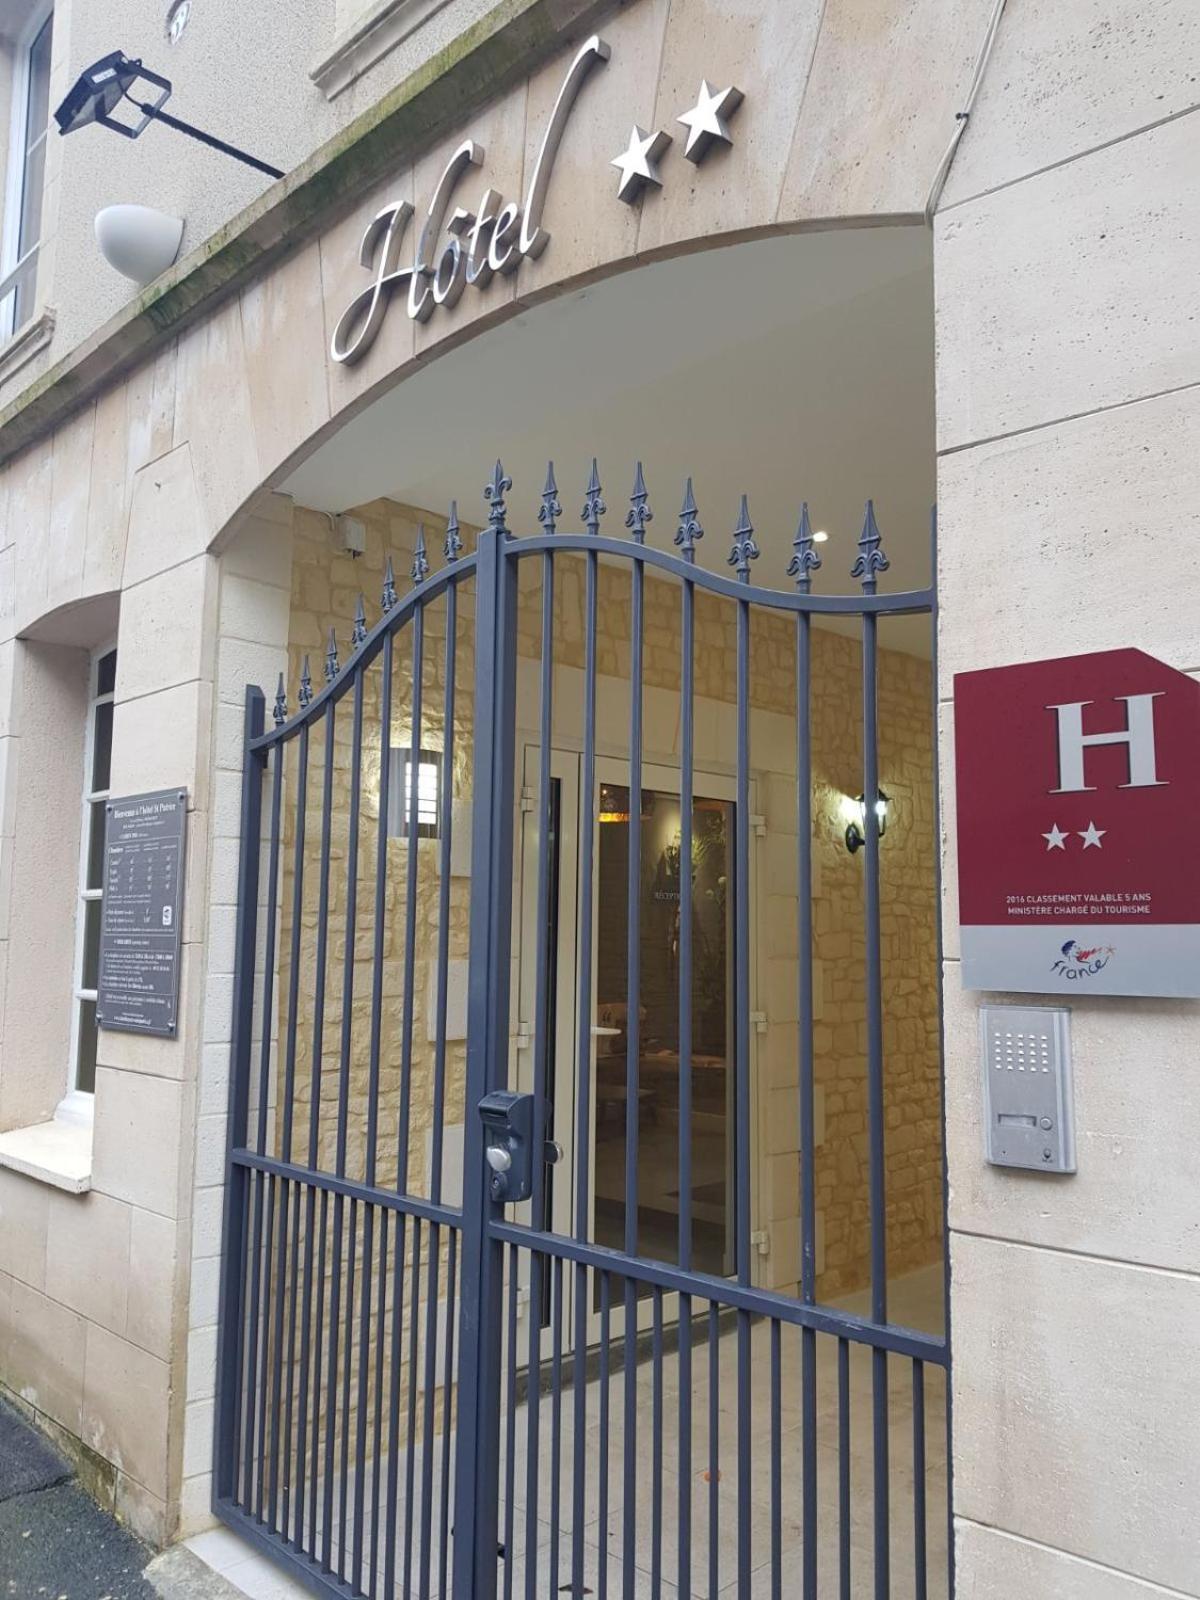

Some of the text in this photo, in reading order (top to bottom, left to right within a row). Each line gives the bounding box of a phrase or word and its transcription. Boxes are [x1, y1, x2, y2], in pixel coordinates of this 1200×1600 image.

[331, 34, 611, 366] Hôtel
[1045, 690, 1170, 794] H
[1006, 895, 1025, 904] 2016
[1026, 894, 1082, 903] CLASSEMENT
[1084, 893, 1123, 902] VALABLE
[1132, 892, 1152, 901] ANS
[1090, 905, 1103, 914] DU
[1104, 905, 1151, 914] TOURISME
